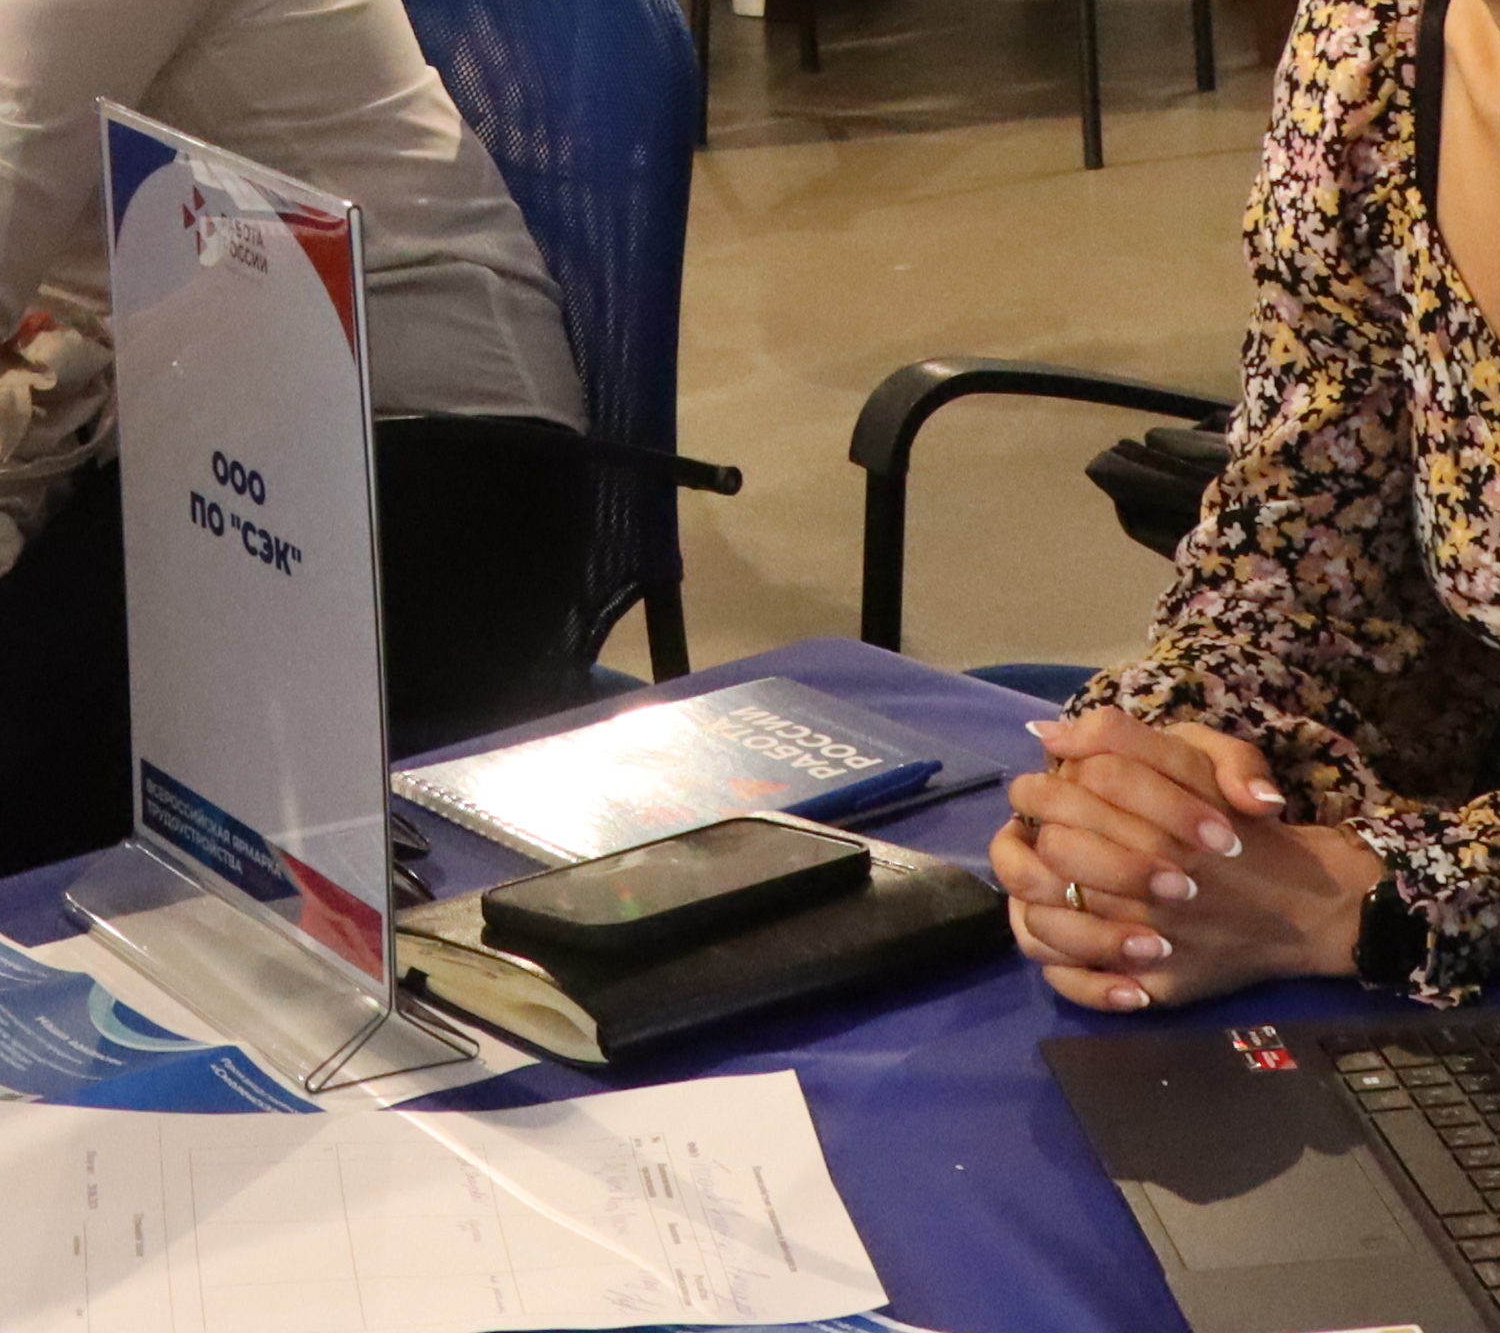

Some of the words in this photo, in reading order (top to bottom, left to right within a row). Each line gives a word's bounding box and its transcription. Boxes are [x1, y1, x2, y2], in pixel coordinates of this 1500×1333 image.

[212, 450, 266, 506] ООО
[190, 490, 225, 537] ПО
[230, 513, 302, 576] "СЭК"
[729, 706, 884, 770] РОССИИ
